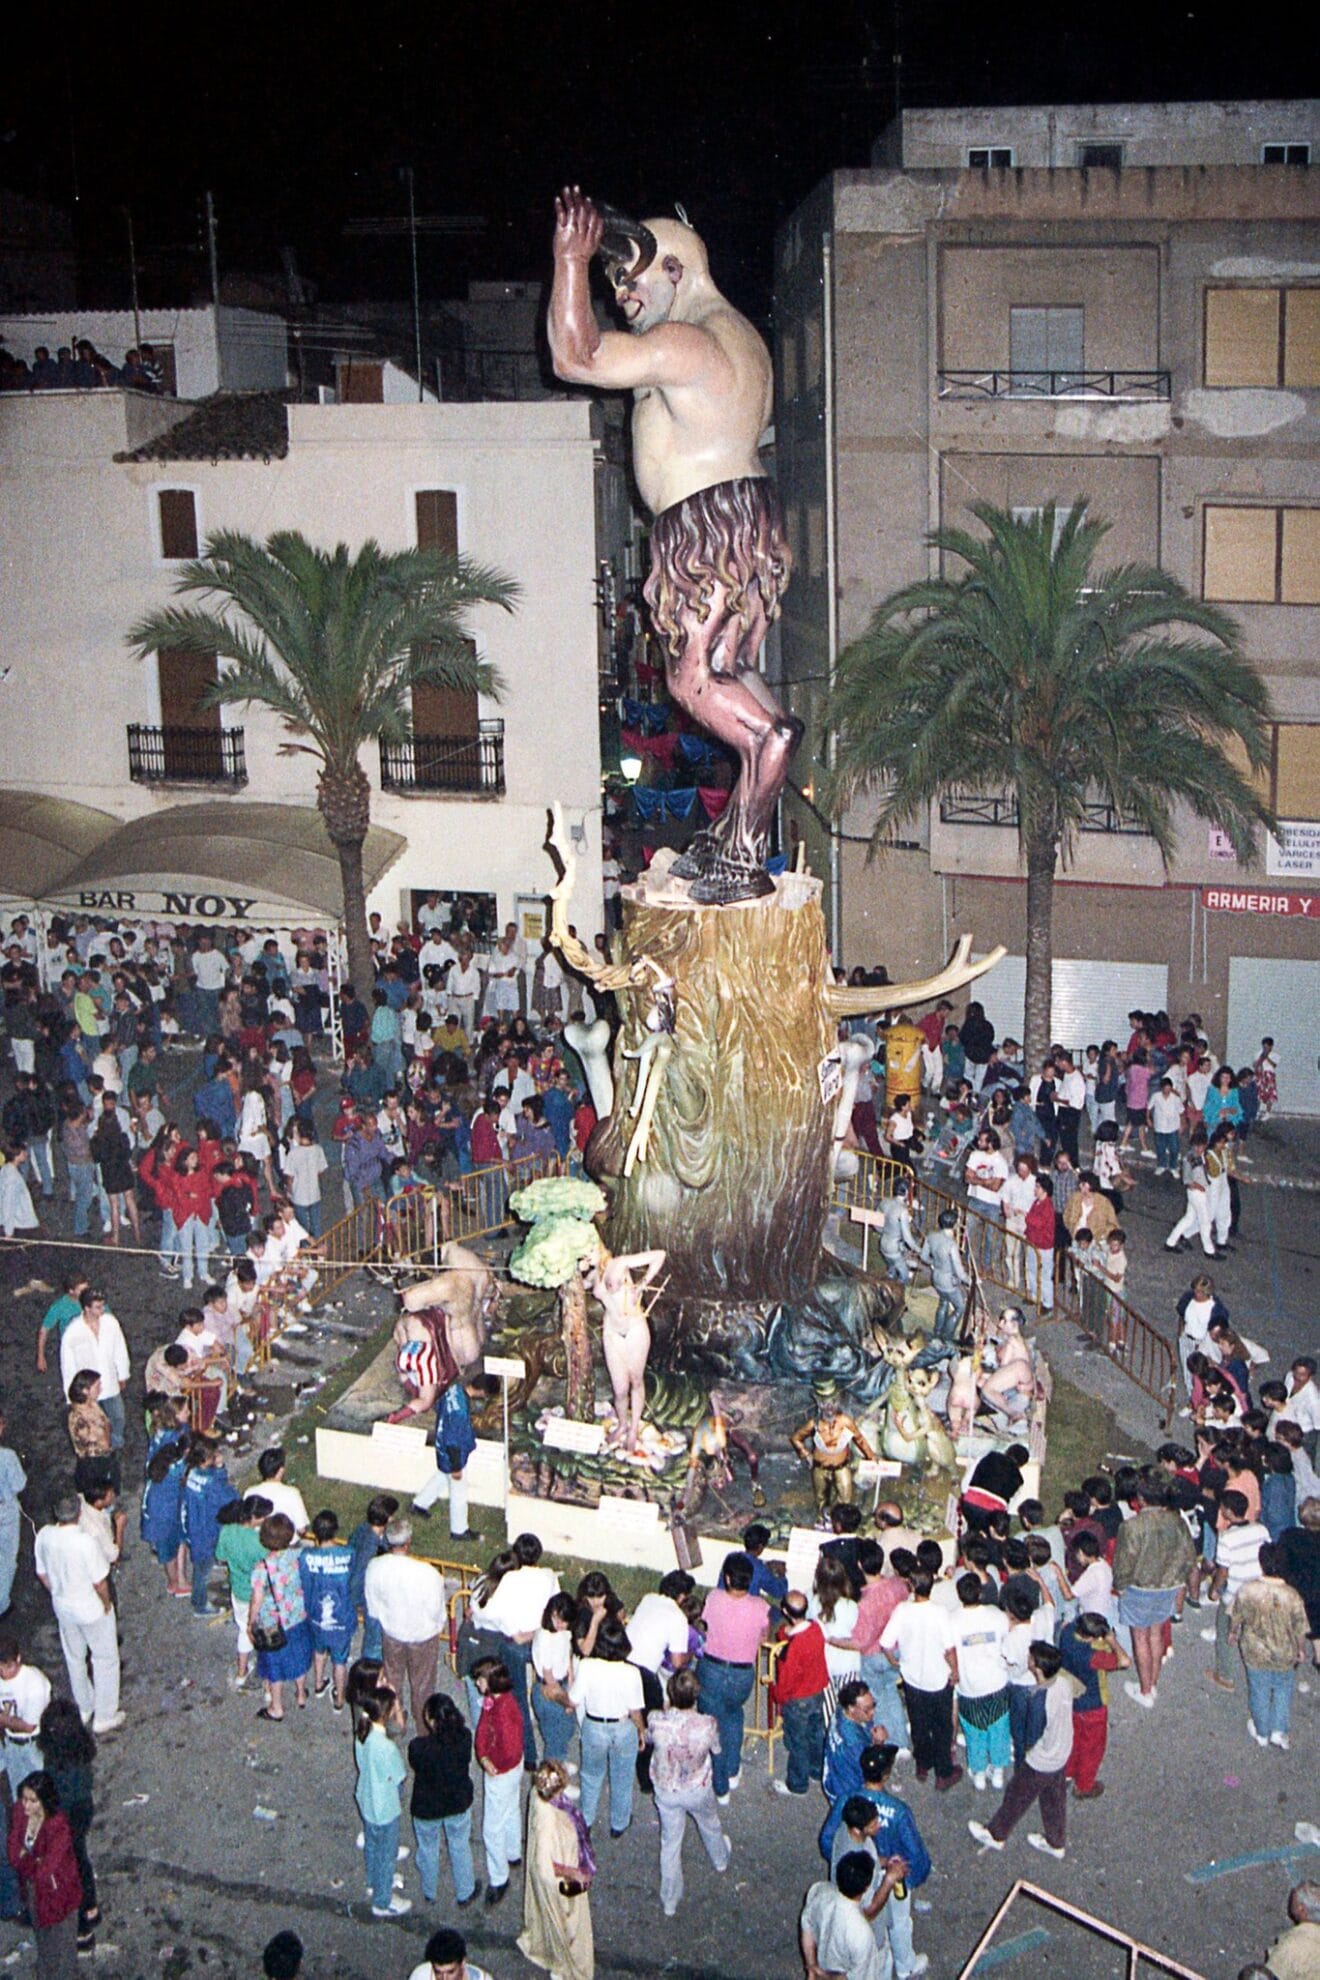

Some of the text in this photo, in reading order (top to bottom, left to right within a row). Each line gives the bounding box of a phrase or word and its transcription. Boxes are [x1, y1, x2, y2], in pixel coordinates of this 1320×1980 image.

[1278, 860, 1313, 869] LASER
[79, 891, 257, 919] BAR NOY
[1207, 891, 1312, 914] ARMERIA Y
